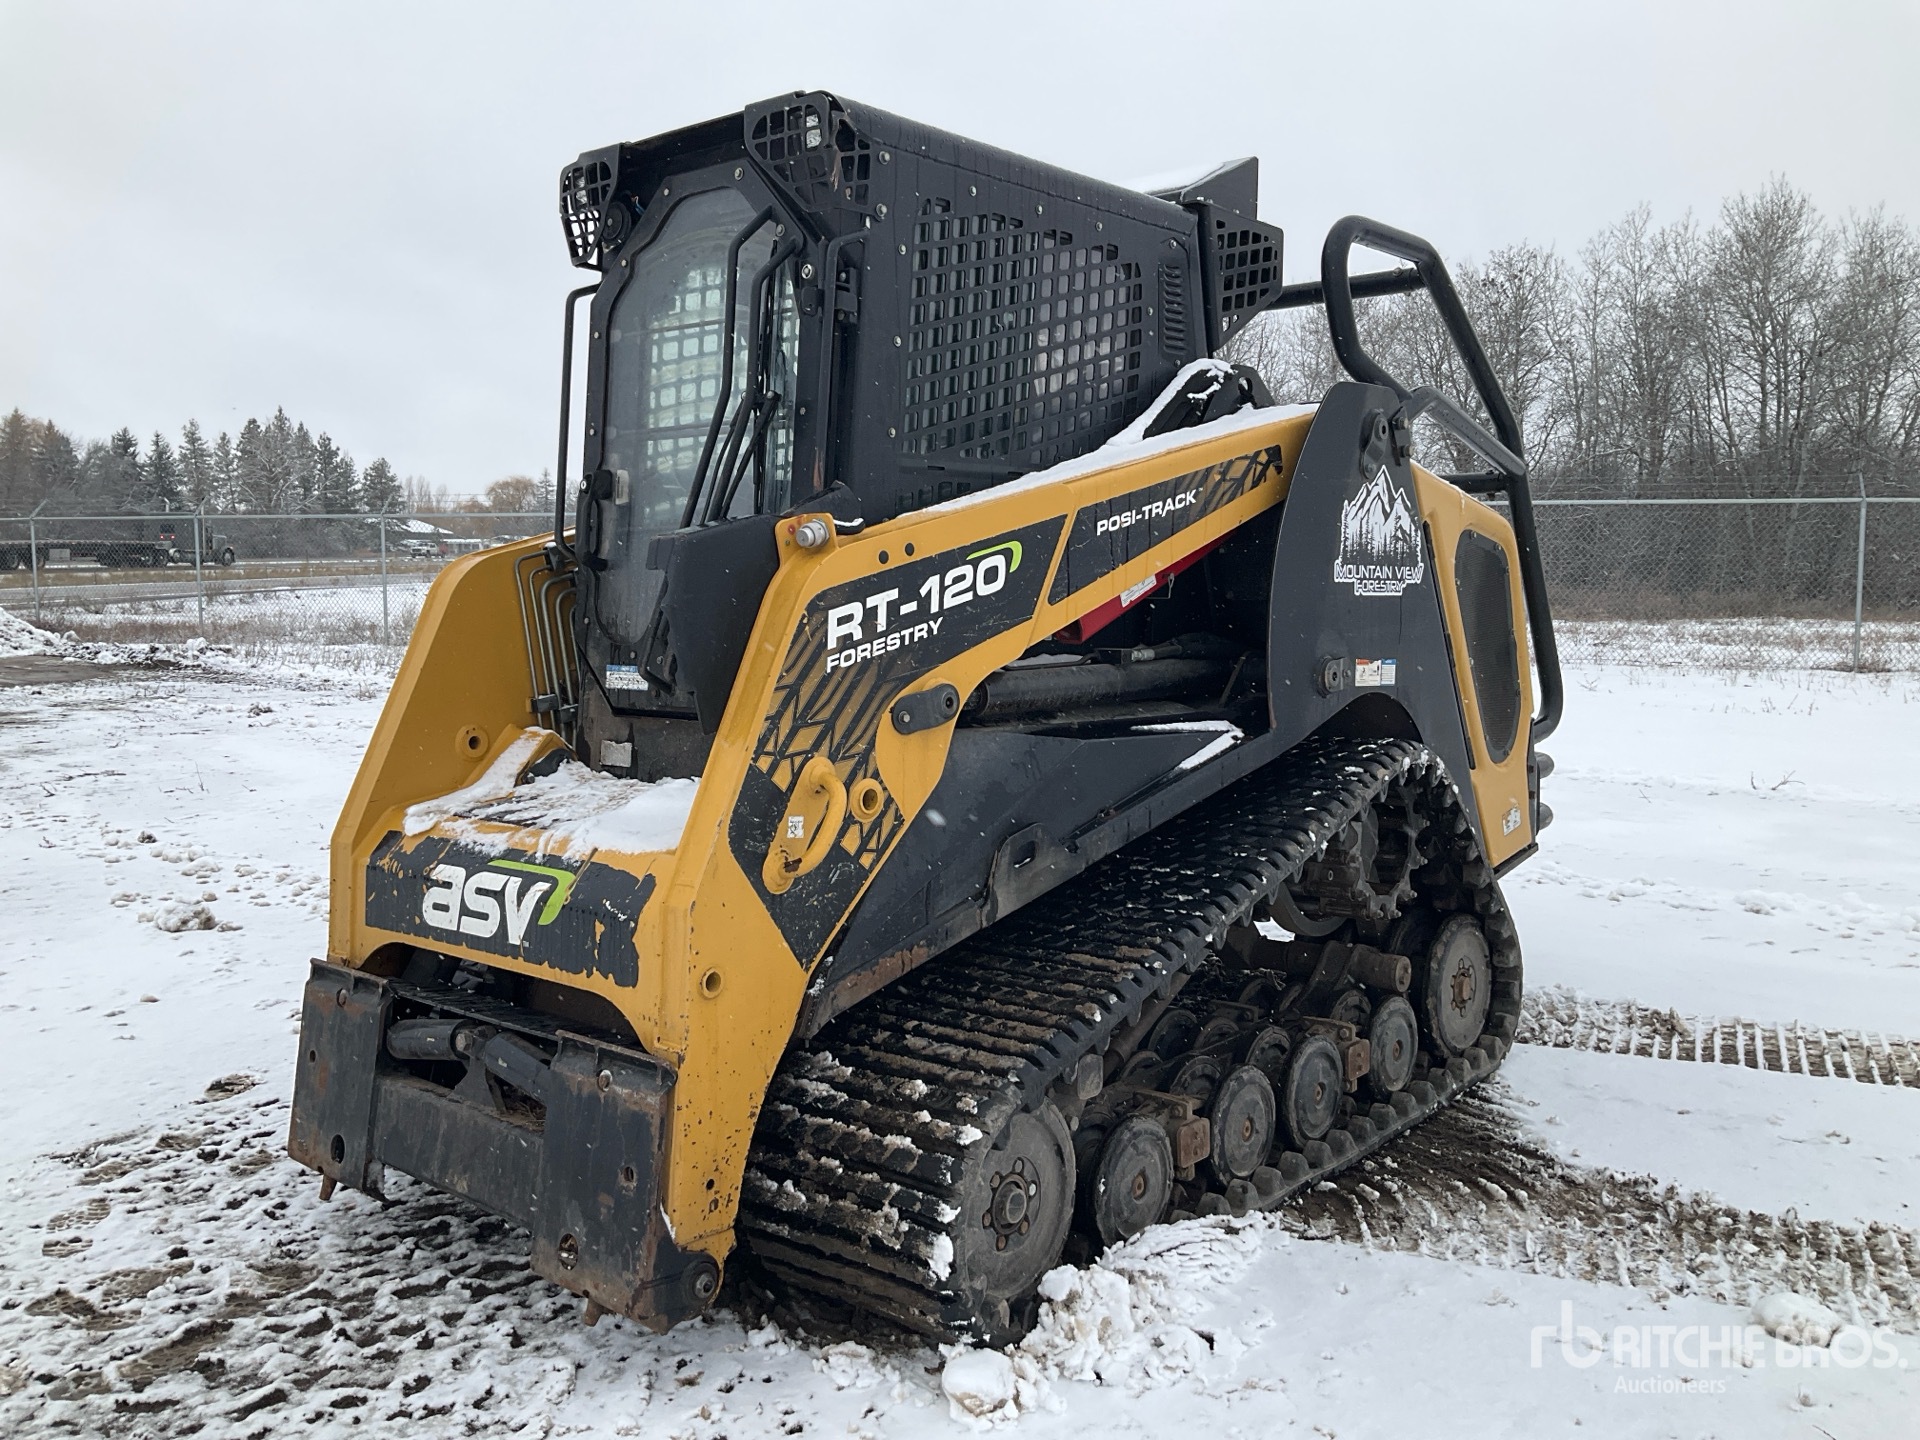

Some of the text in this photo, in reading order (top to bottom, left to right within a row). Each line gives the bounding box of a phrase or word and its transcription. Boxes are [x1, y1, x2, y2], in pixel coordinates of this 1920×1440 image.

[1335, 564, 1423, 580] MOUNTAIN VIEW
[1355, 580, 1404, 592] FORESTRY
[826, 553, 1007, 651] RT-120
[826, 617, 944, 673] FORESTRY
